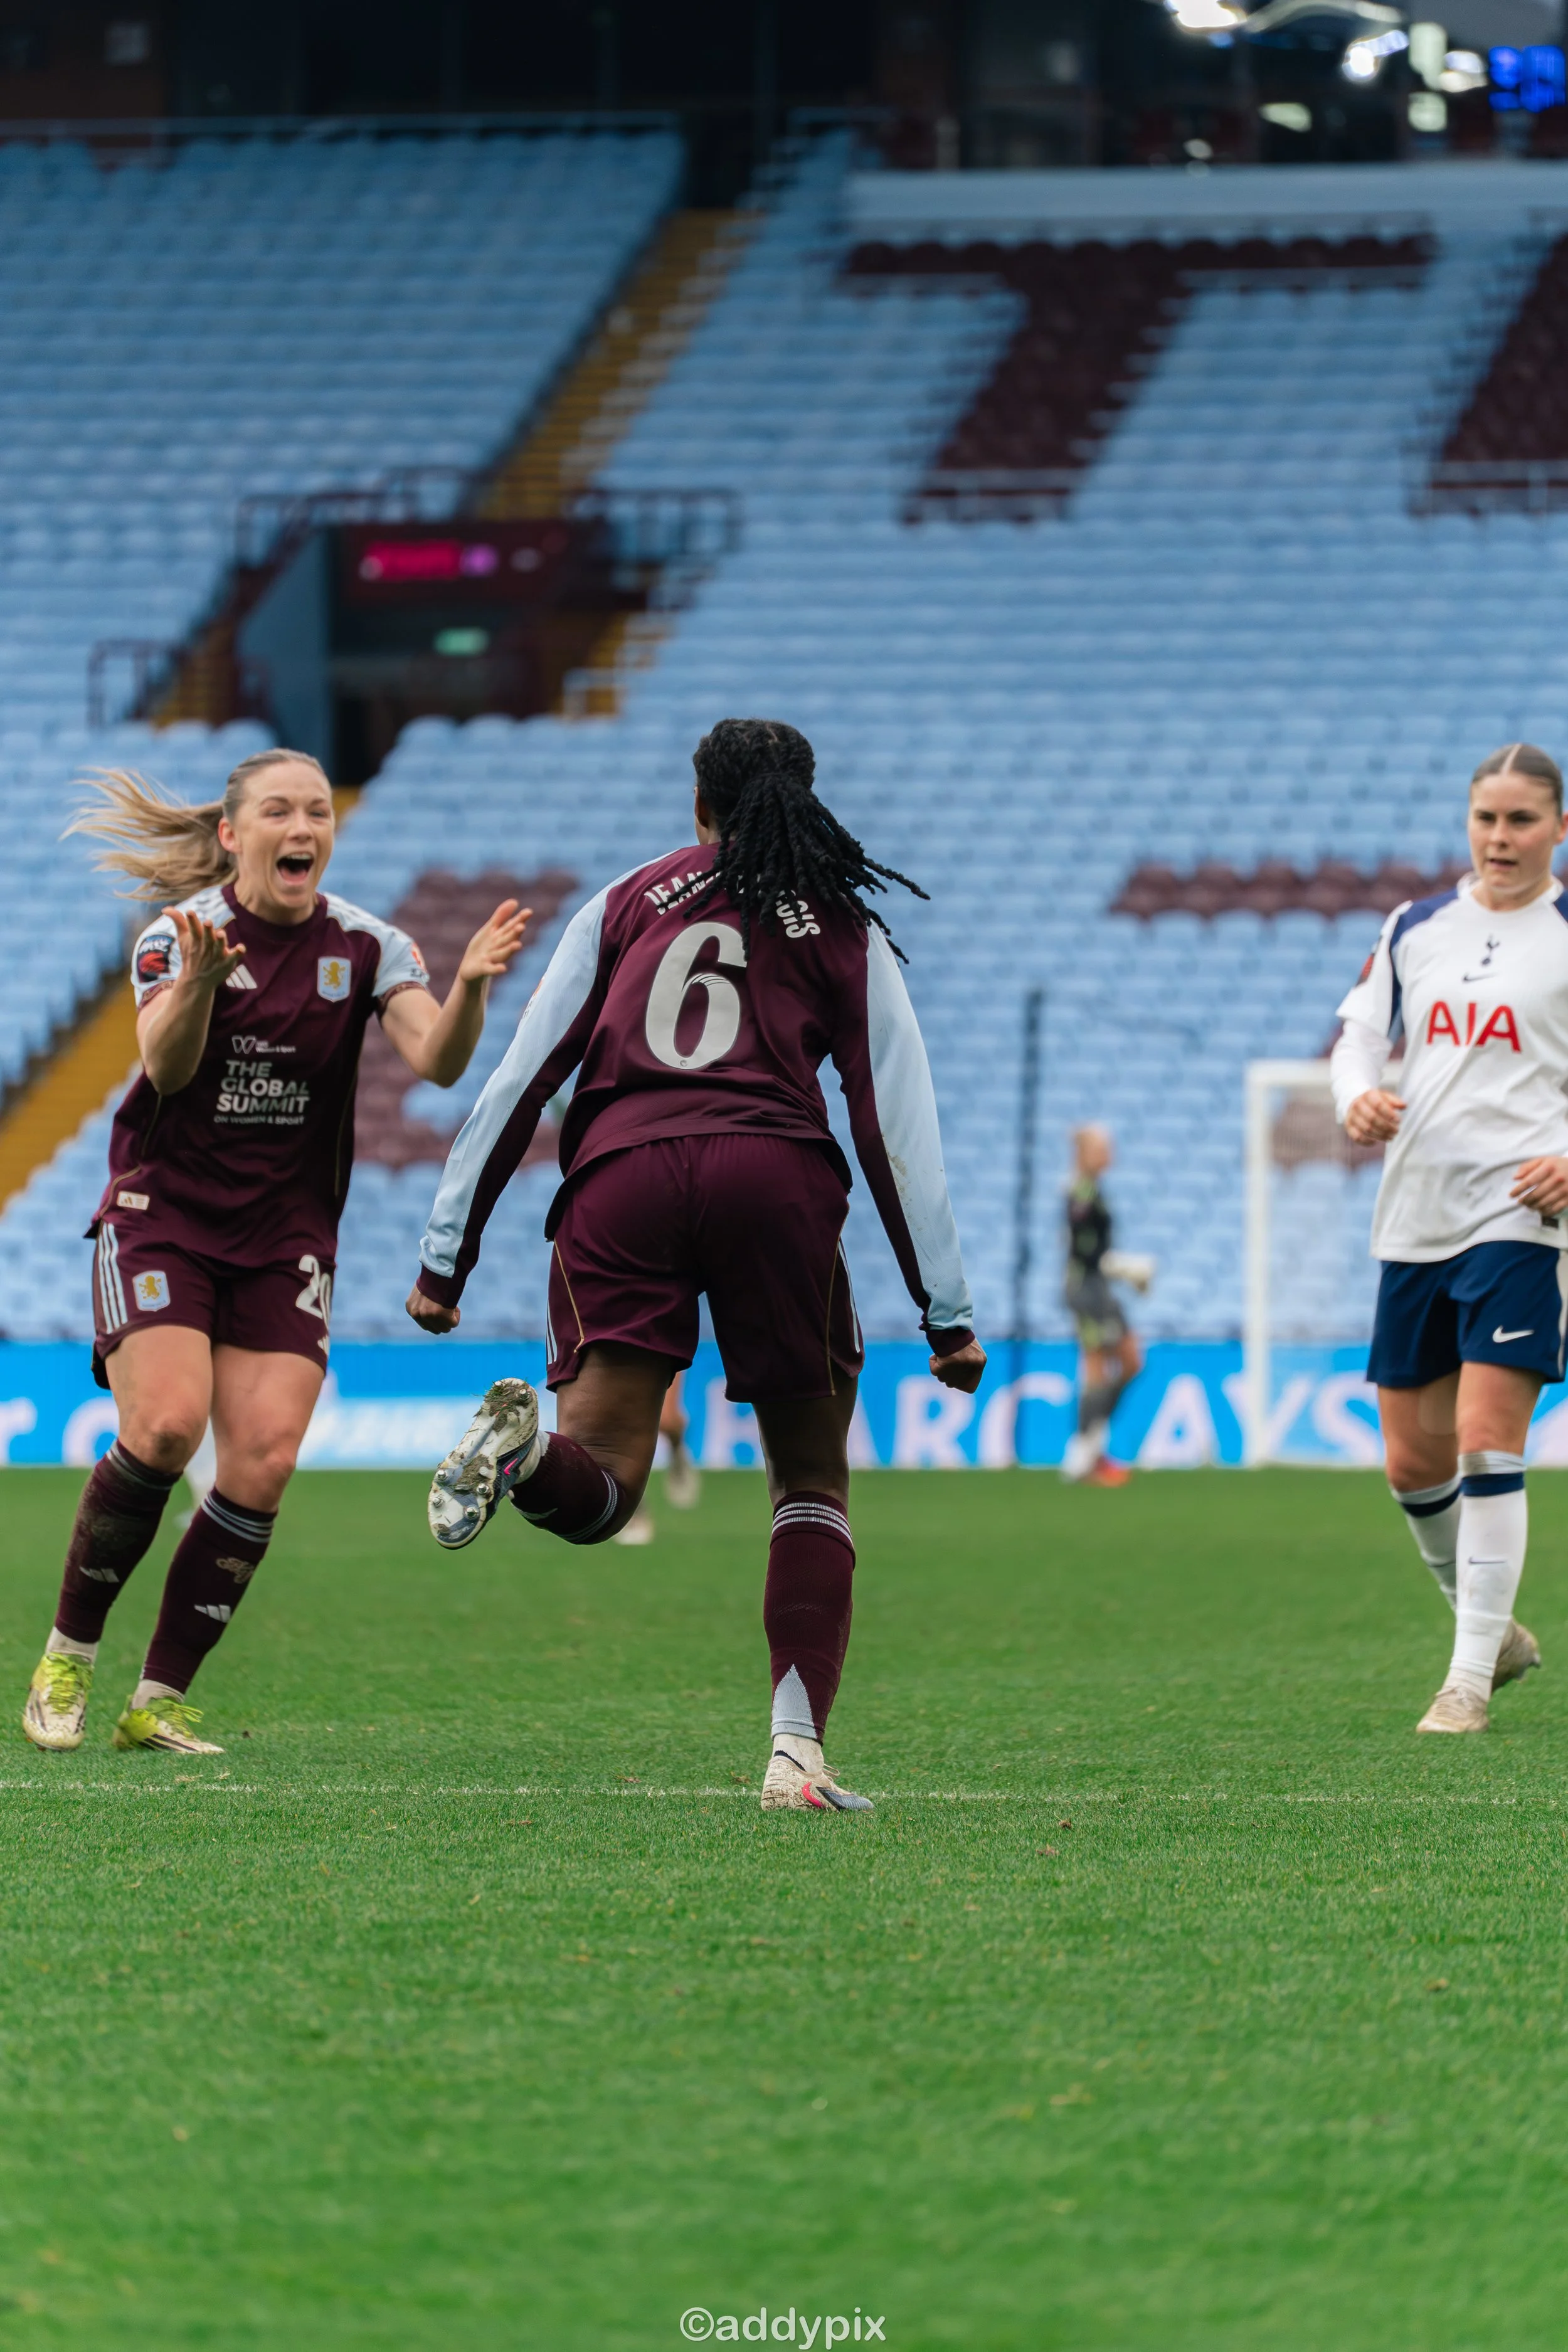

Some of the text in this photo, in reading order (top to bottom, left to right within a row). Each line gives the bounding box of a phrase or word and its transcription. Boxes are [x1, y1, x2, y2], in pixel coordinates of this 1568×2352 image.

[645, 921, 748, 1071] 6
[1426, 1000, 1521, 1053] AIA
[226, 1060, 272, 1078] THE
[221, 1077, 309, 1098] GLOBAL
[216, 1093, 310, 1114] SUMMIT
[214, 1115, 305, 1125] ON WOMEN & SPORT
[295, 1254, 332, 1331] 20
